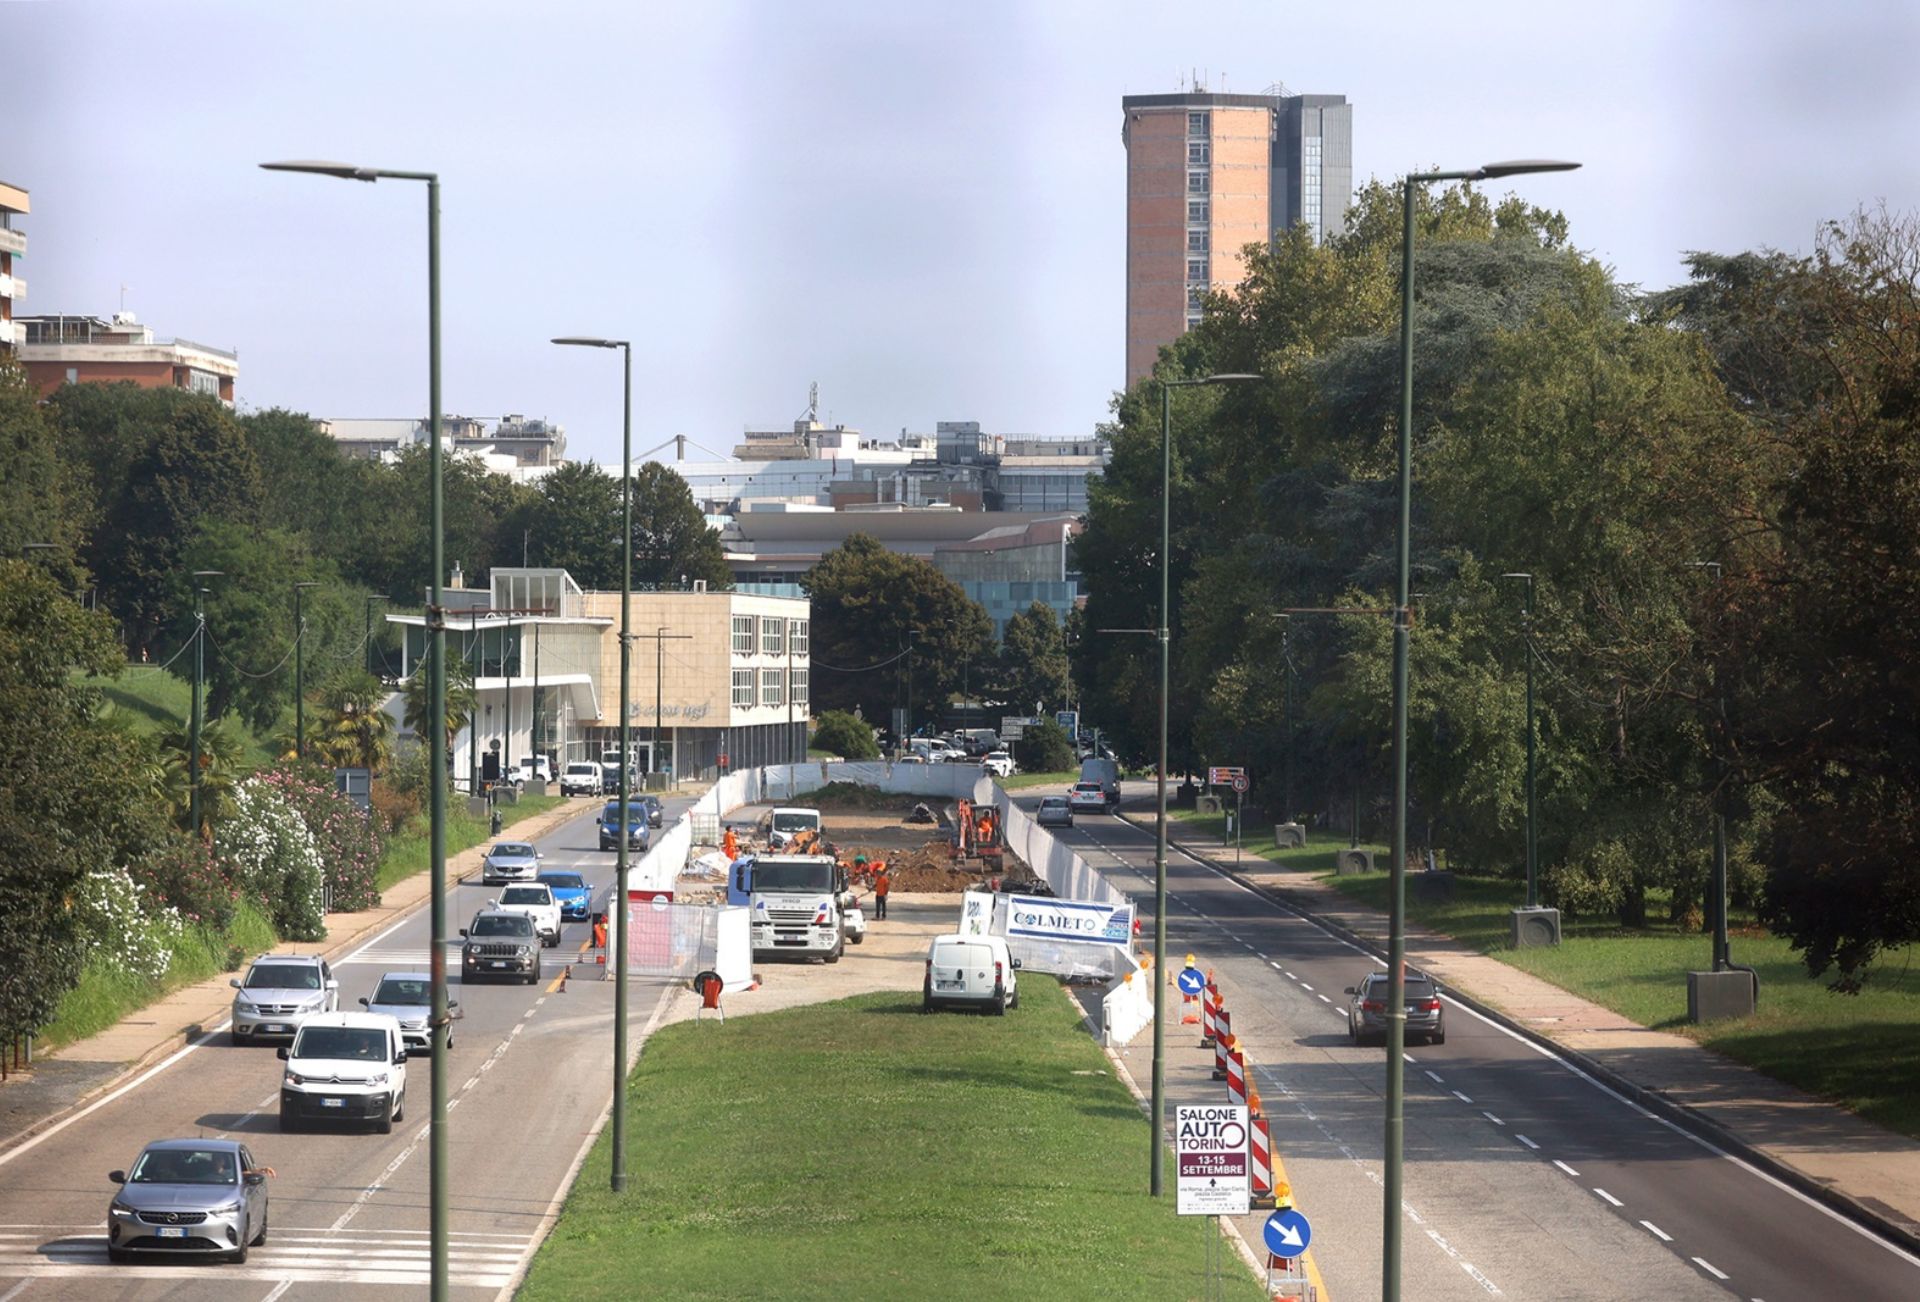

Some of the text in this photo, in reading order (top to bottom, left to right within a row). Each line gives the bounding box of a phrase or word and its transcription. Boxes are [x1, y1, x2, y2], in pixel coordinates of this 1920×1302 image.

[1180, 1109, 1237, 1120] SALONE
[1198, 1155, 1226, 1165] 13-15
[1182, 1165, 1244, 1175] SETTEMBRE
